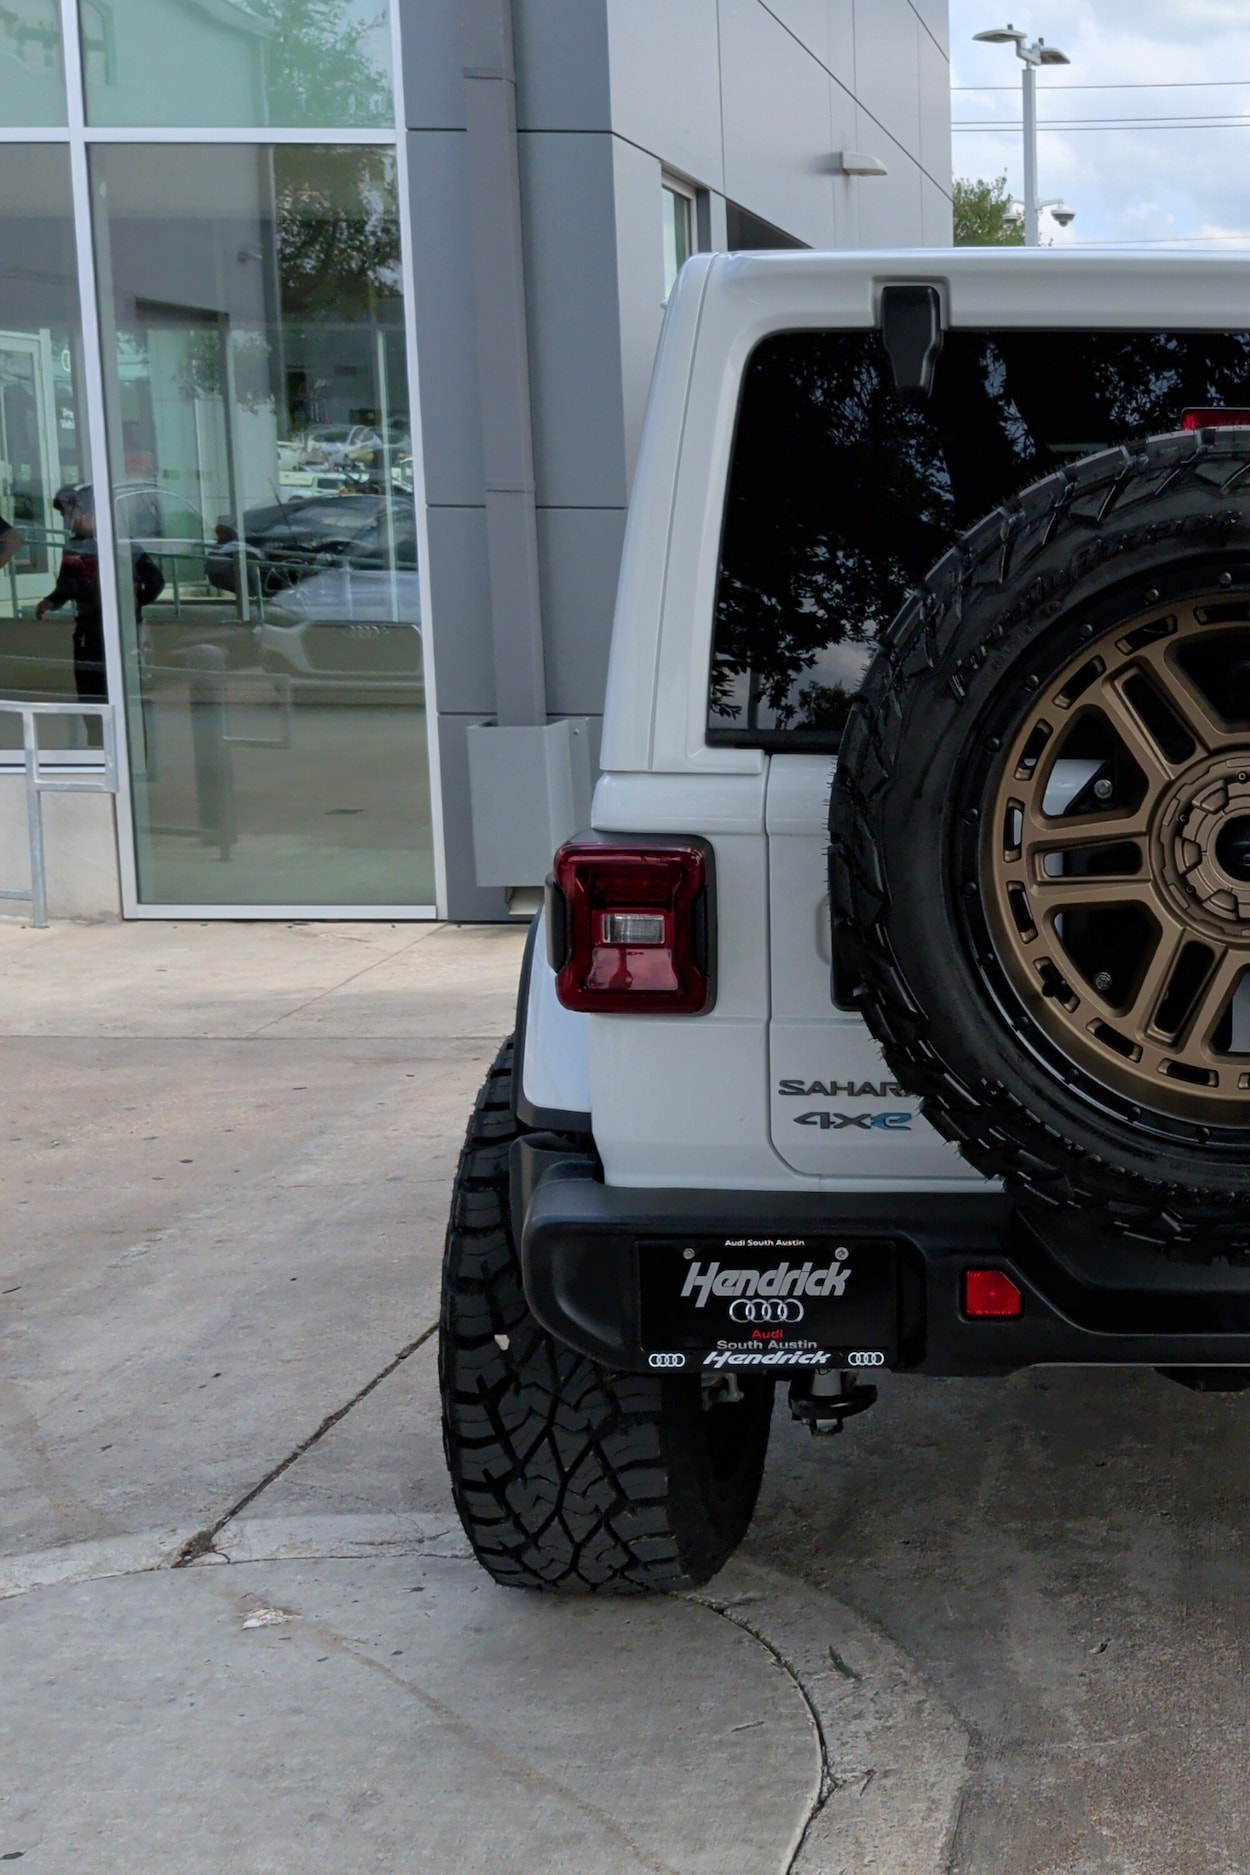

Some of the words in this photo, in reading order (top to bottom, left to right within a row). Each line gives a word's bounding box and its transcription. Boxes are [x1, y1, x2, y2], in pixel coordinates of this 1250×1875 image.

[778, 1079, 916, 1098] SAHAR
[724, 1239, 746, 1247] Audi
[746, 1238, 775, 1247] South
[775, 1239, 805, 1247] Austin
[680, 1261, 852, 1308] Hendrick
[752, 1329, 784, 1340] Audi
[716, 1339, 764, 1351] South
[767, 1339, 817, 1350] Austin
[703, 1350, 831, 1369] Hendrick
